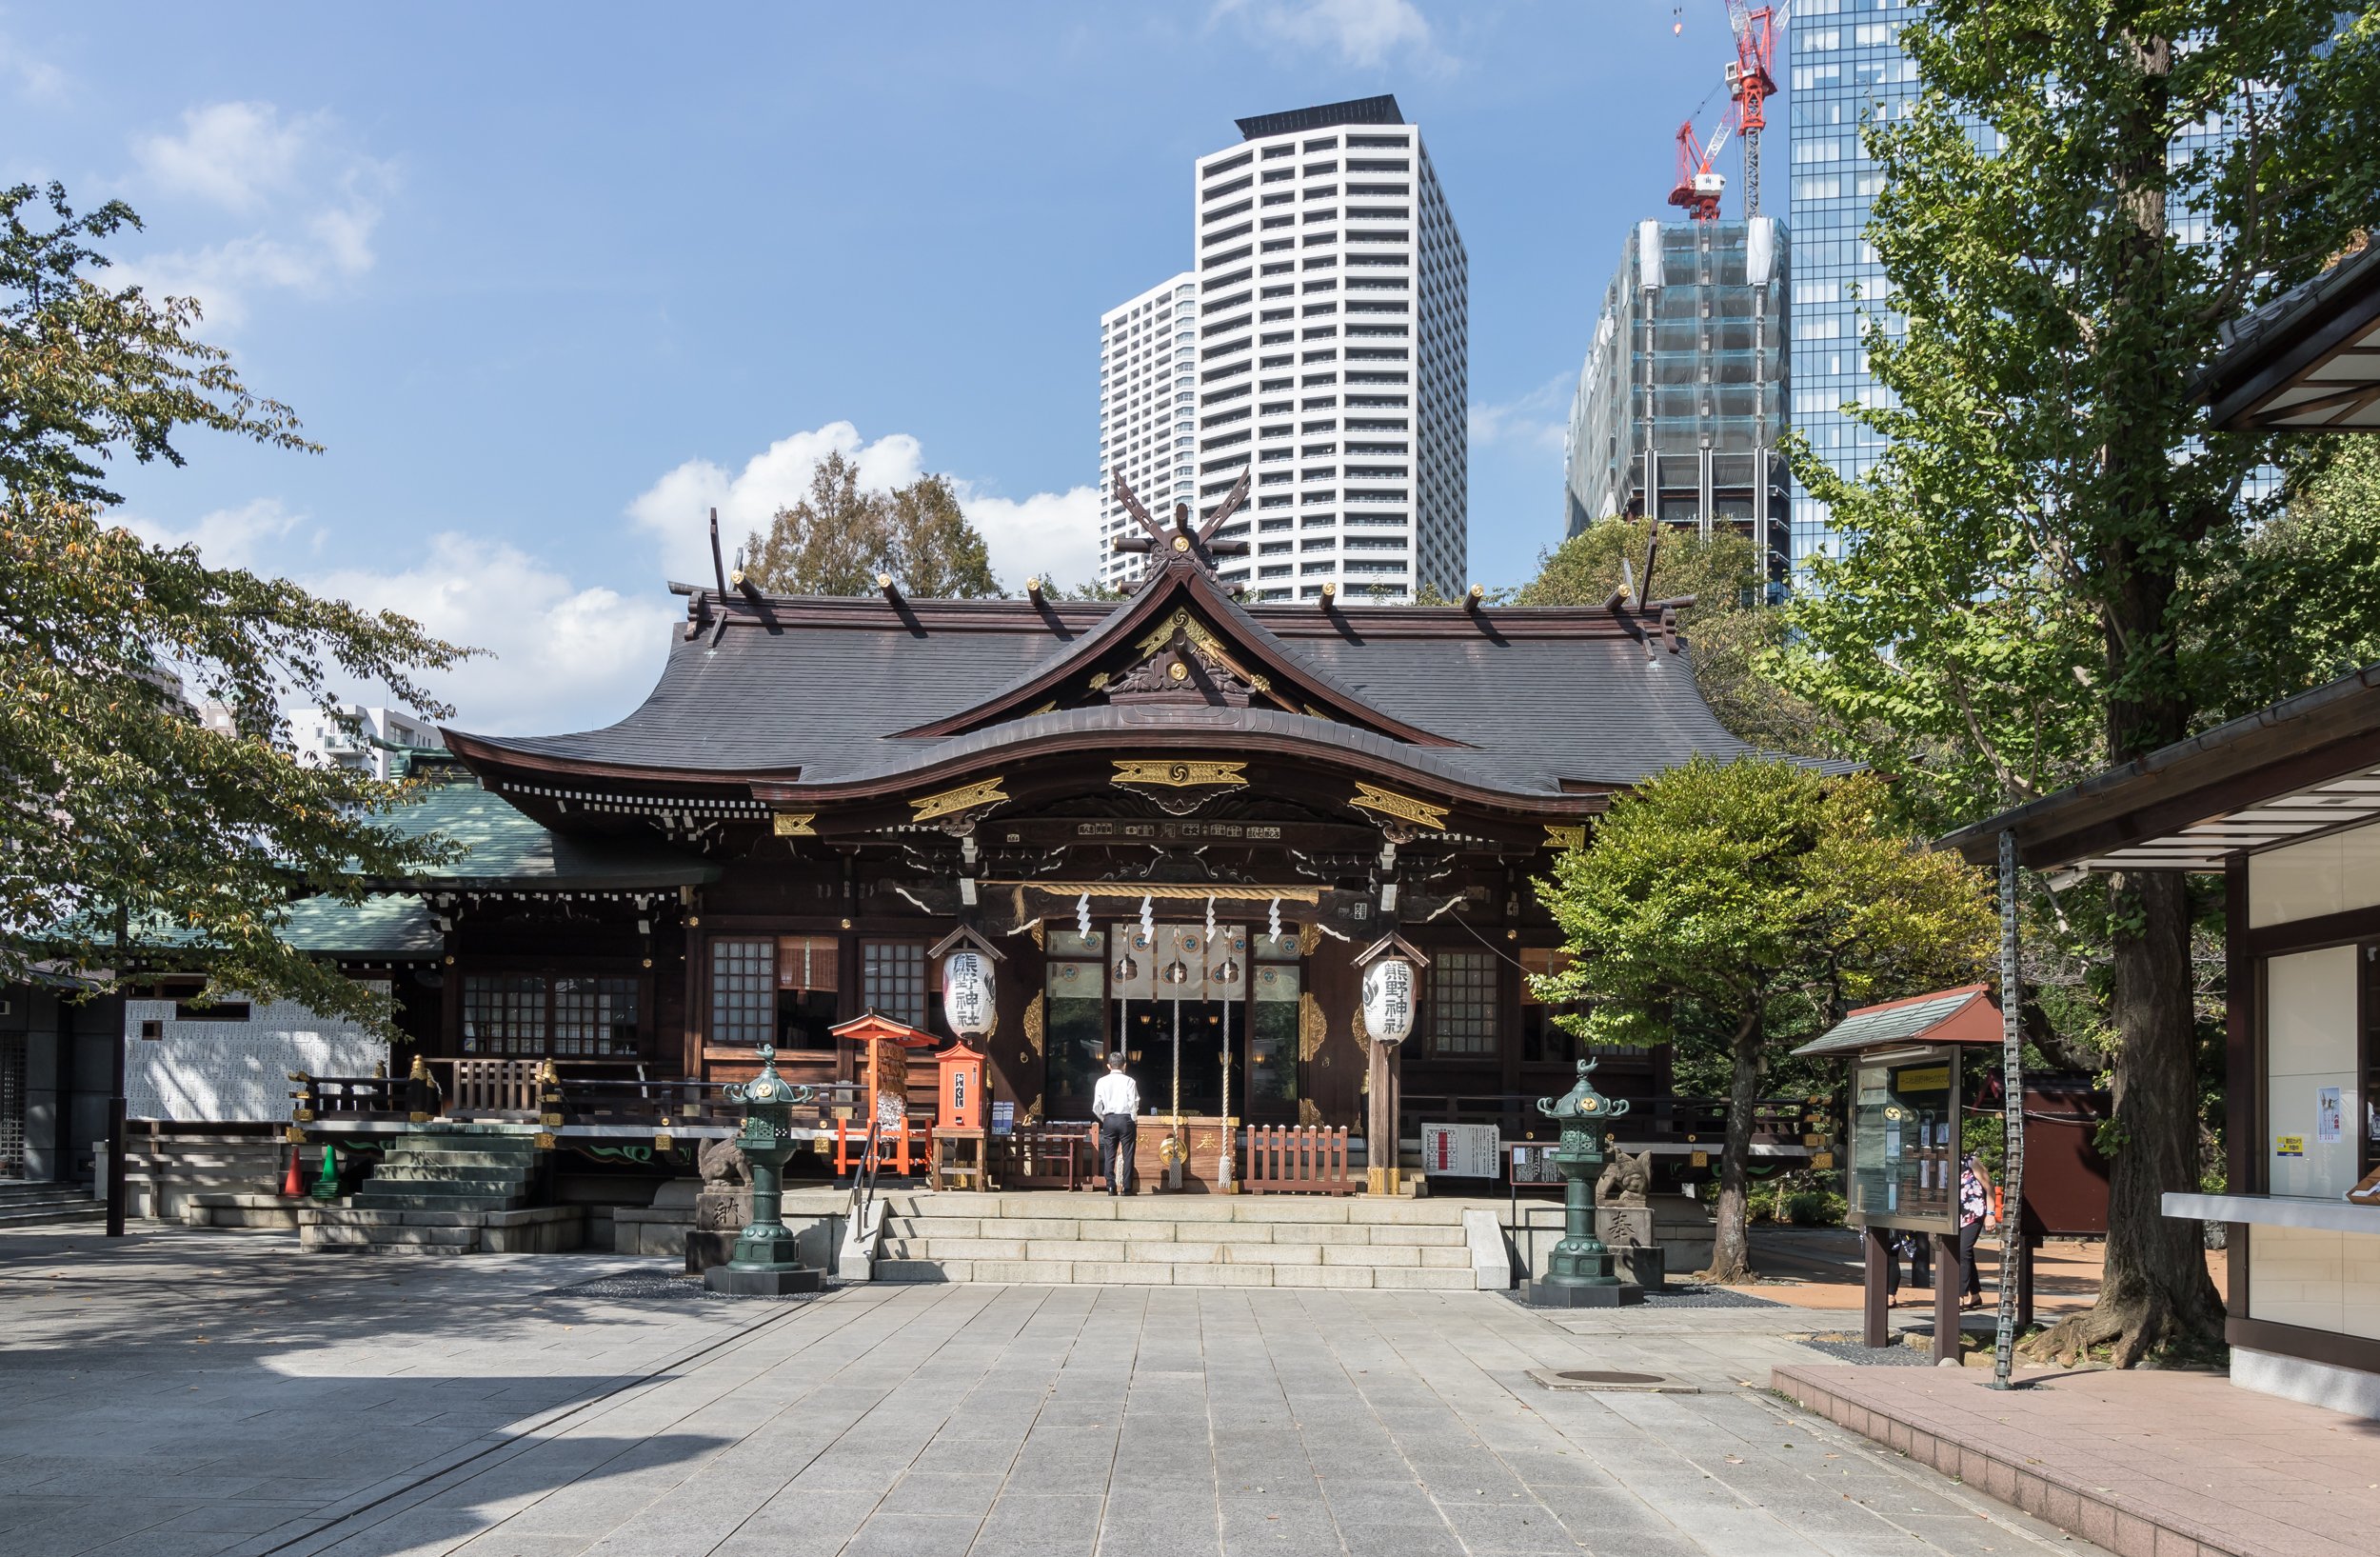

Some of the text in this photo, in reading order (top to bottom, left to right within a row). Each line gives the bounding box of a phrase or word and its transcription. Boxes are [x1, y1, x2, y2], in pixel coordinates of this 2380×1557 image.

[954, 953, 981, 1027] 熊野神社
[1383, 961, 1408, 1034] 熊野神社
[955, 1073, 964, 1108] おみくじ
[1196, 1131, 1219, 1152] 奉
[712, 1196, 744, 1227] 納
[1608, 1210, 1636, 1243] 奉
